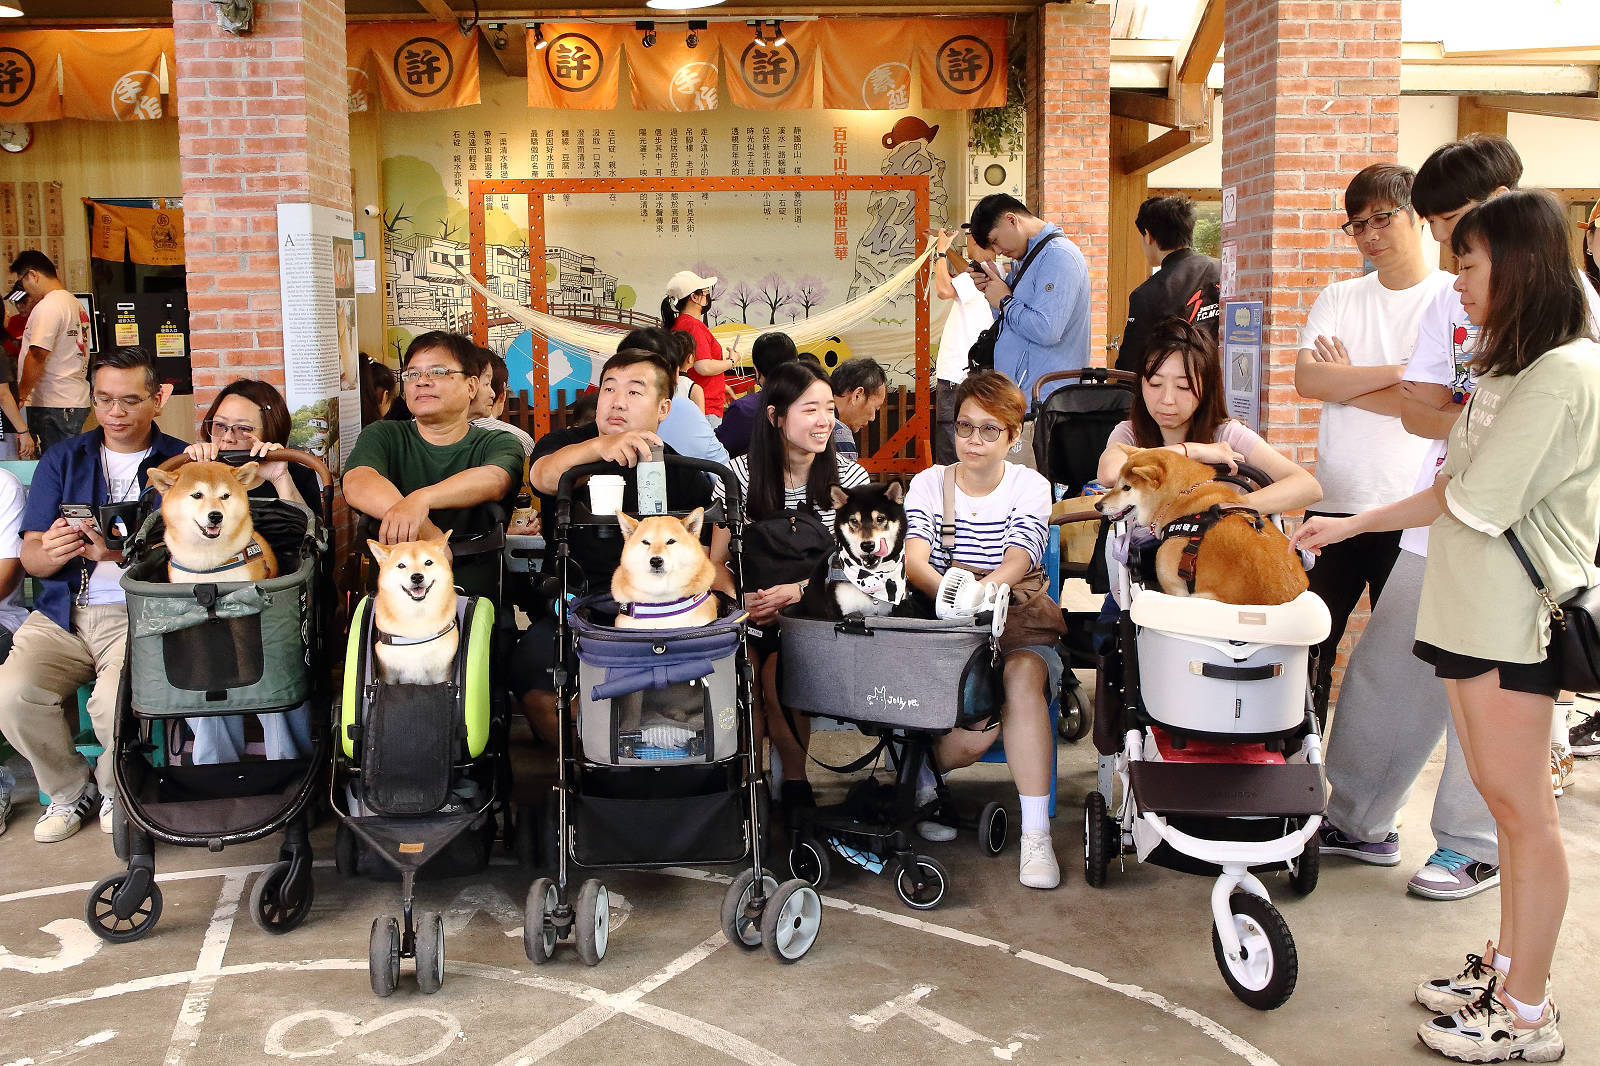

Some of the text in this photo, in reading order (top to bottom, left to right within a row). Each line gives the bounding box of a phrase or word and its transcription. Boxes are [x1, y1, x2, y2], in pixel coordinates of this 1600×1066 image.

[404, 49, 441, 85] 許
[555, 44, 591, 81] 許
[752, 49, 788, 85] 許
[948, 47, 982, 82] 許
[833, 126, 848, 261] 百年山的絕世風華
[887, 696, 907, 711] Jolly
